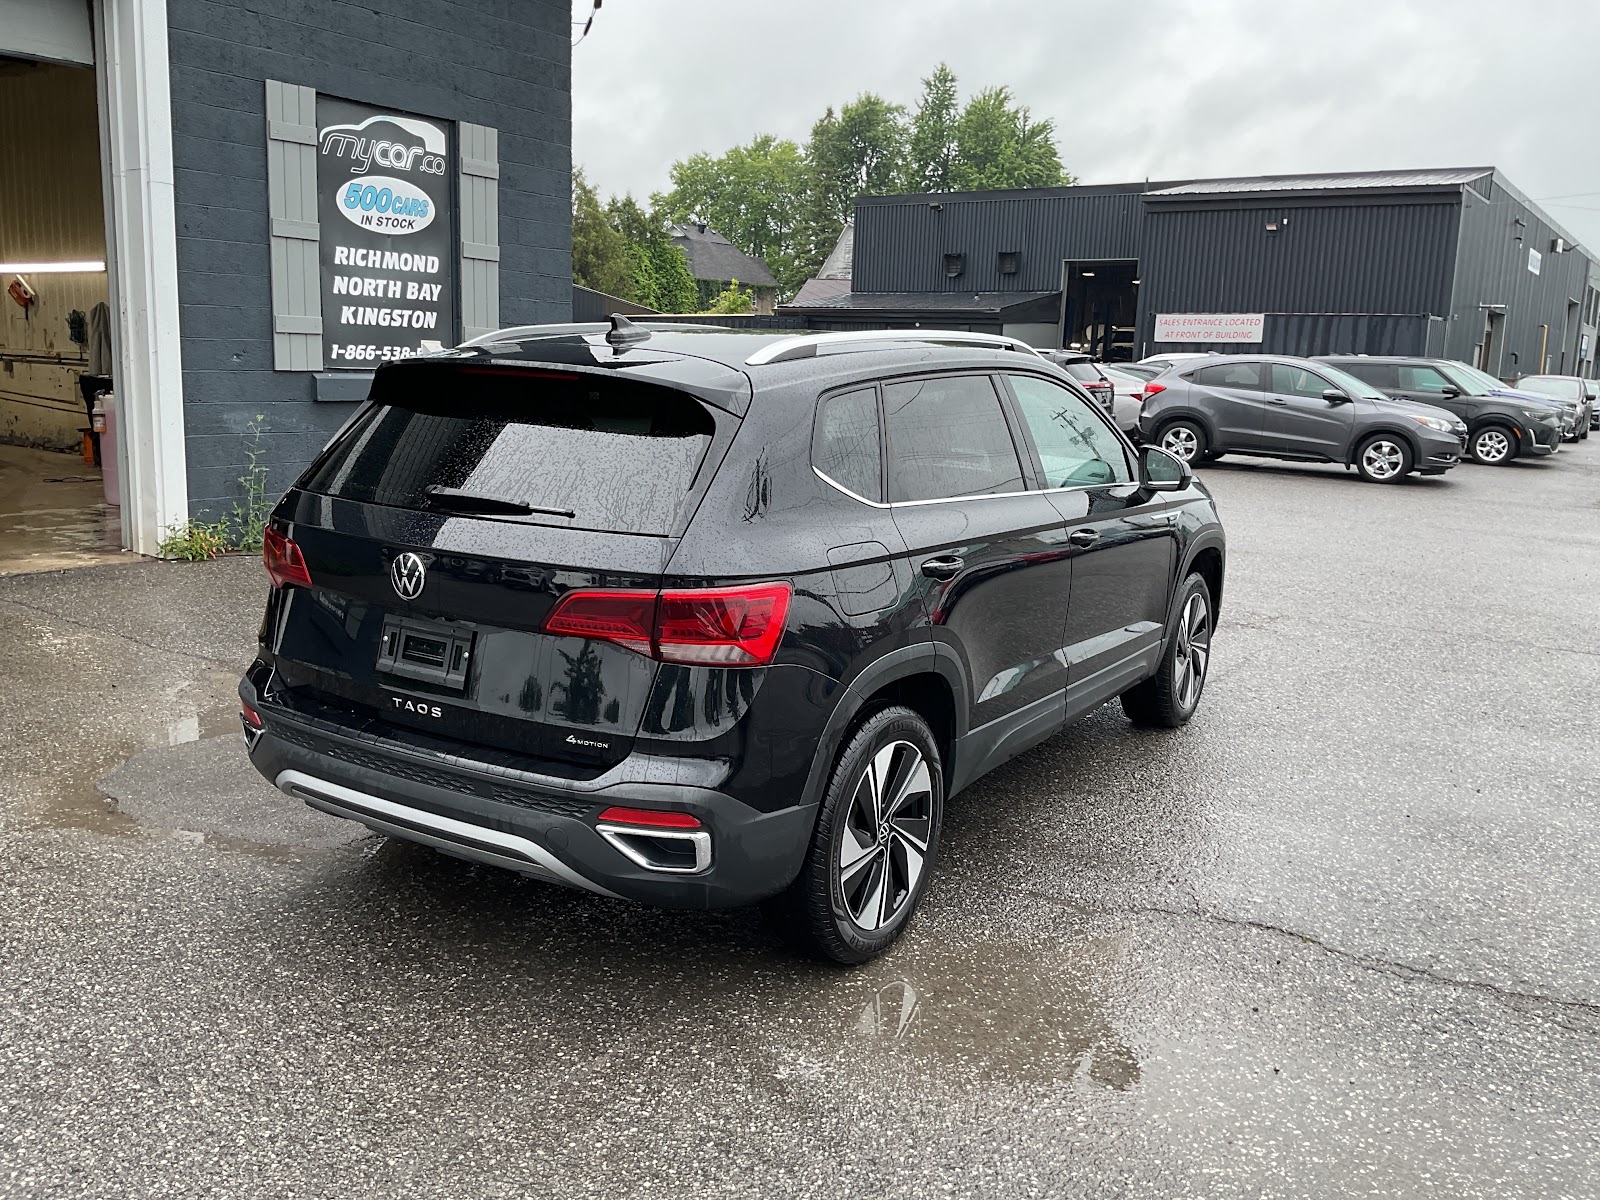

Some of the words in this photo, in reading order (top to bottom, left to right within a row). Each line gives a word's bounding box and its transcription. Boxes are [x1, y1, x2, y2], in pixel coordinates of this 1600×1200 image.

[360, 215, 372, 226] IN
[376, 216, 416, 230] STOCK
[334, 246, 439, 273] RICHMOND
[333, 276, 402, 299] NORTH
[406, 282, 442, 302] BAY
[340, 306, 437, 329] KINGSTON
[1159, 318, 1181, 327] SALES
[1182, 318, 1223, 327] ENTRANCE
[1225, 318, 1261, 327] LOCATED
[1164, 331, 1174, 339] AT
[1175, 331, 1201, 339] FRONT
[1202, 331, 1213, 339] OF
[1215, 331, 1252, 339] BUILDING
[392, 697, 442, 718] TAOS
[565, 734, 609, 749] 4MOTION
